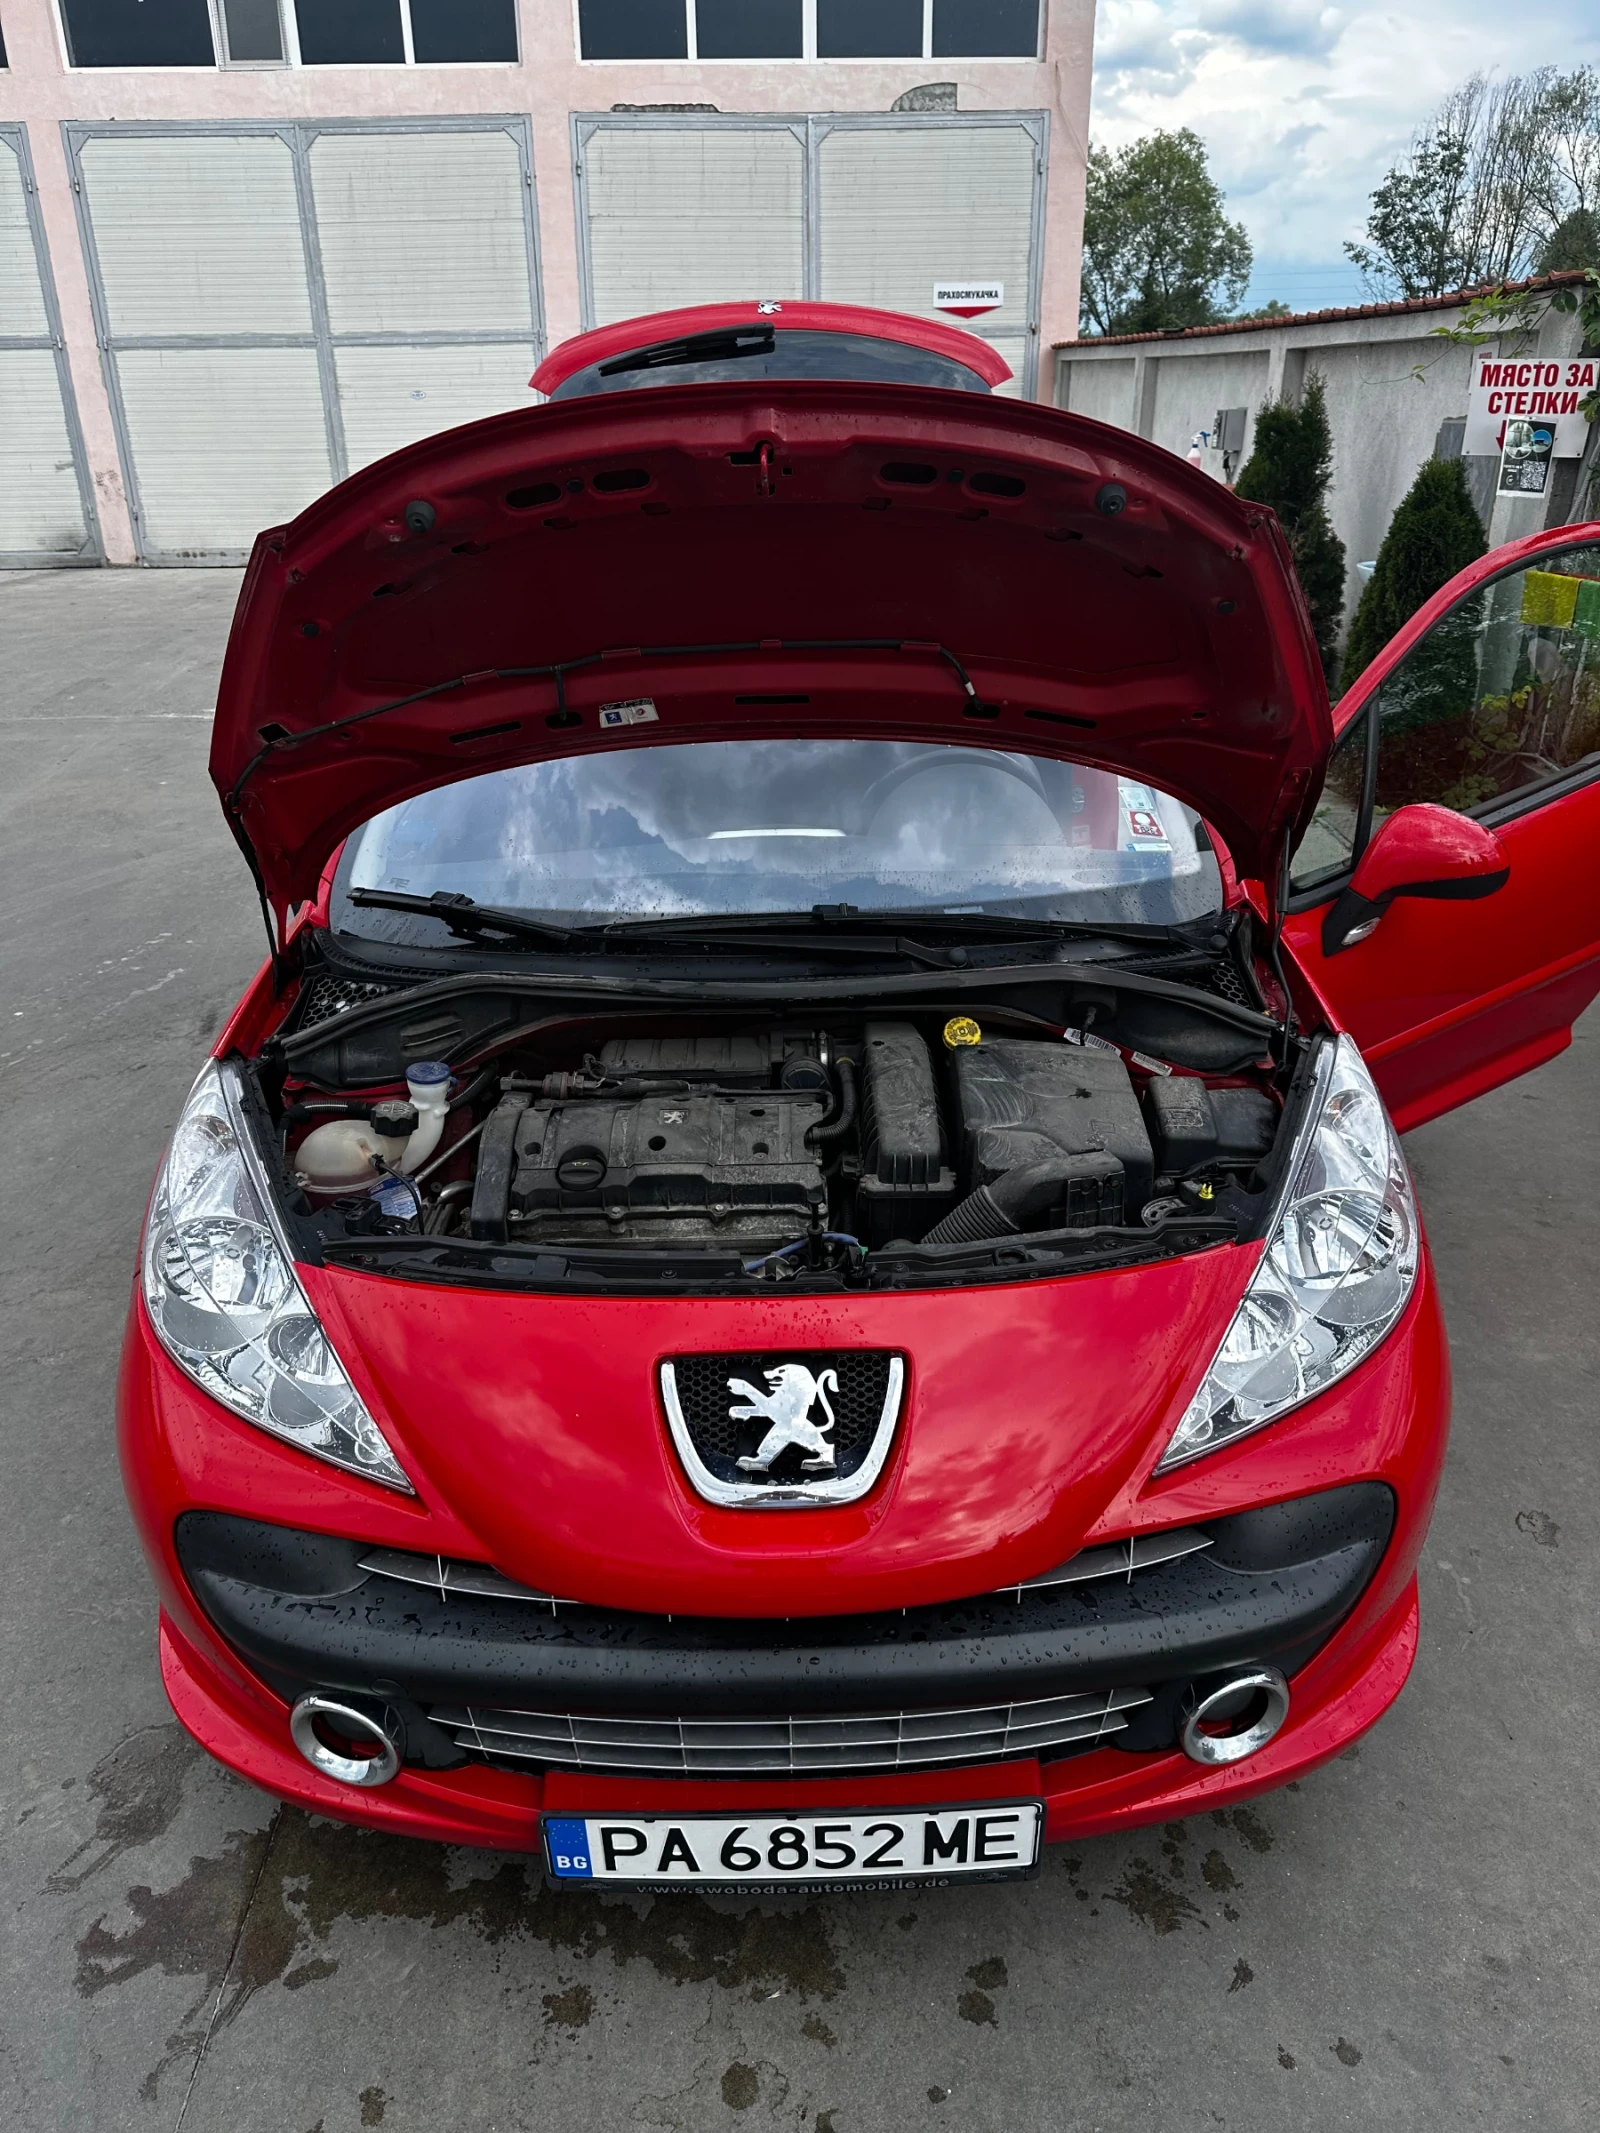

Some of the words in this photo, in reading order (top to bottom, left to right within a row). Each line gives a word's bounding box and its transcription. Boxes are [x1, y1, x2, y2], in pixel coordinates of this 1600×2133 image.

[937, 290, 999, 299] ПРАХОСМУКАЧКА
[1480, 364, 1559, 387] МЯСТО
[1565, 364, 1594, 387] ЗА
[1488, 392, 1579, 415] СТЕЛКИ
[720, 1823, 904, 1872] 6852
[923, 1814, 1020, 1865] ME
[556, 1855, 588, 1869] BG
[636, 1877, 950, 1895] www.swoboda-automobile.de
